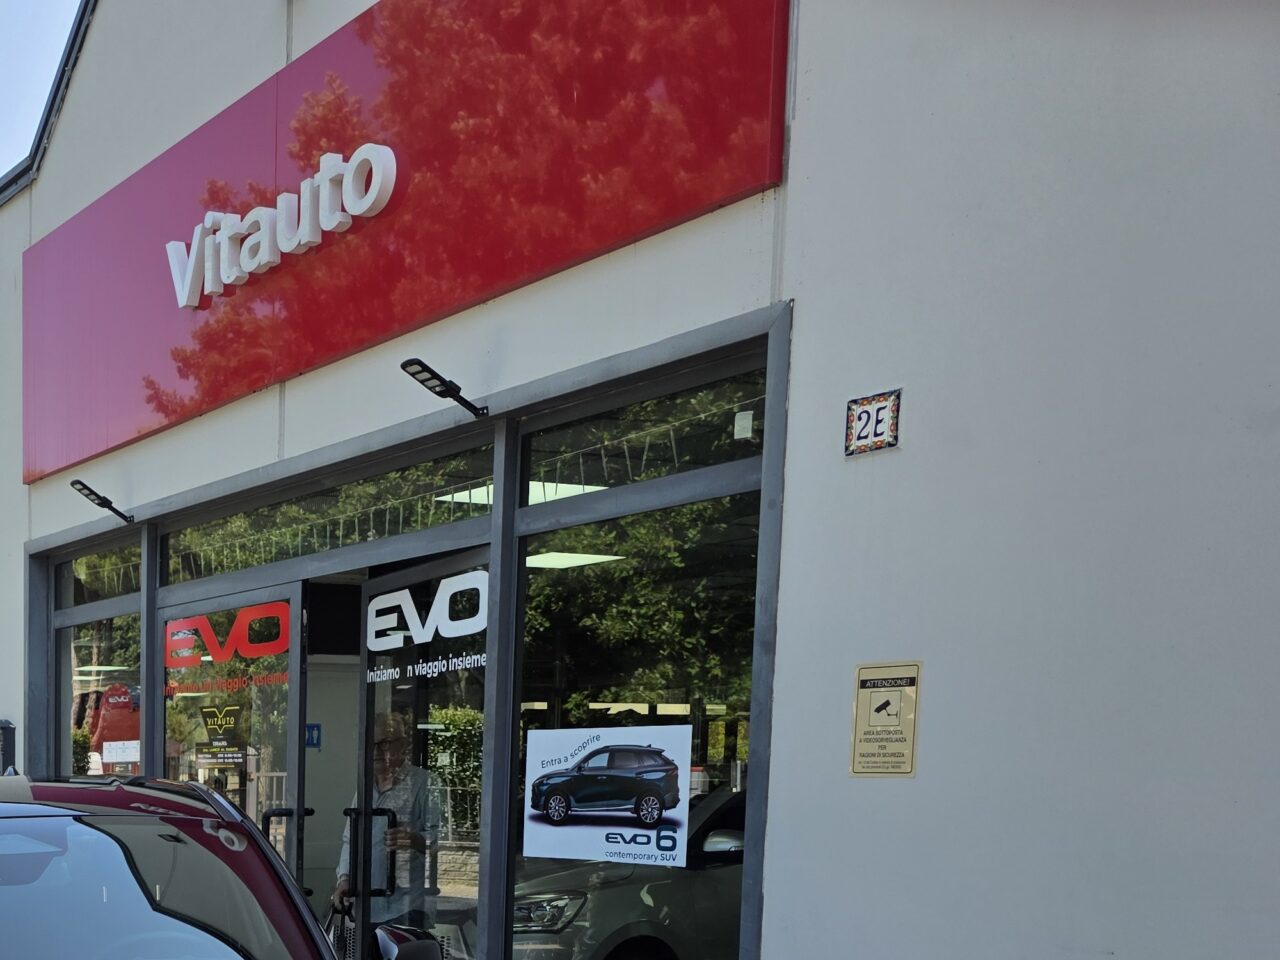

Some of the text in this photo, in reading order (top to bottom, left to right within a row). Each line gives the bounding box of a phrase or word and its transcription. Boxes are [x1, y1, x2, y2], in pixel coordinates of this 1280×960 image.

[166, 142, 397, 308] Vitauto
[856, 405, 888, 441] 2E
[366, 570, 489, 651] EVO
[164, 601, 290, 668] EVO
[367, 665, 400, 683] Iniziamo
[415, 656, 447, 678] viaggio
[449, 652, 487, 671] insieme
[866, 679, 910, 687] ATTENZIONE!
[207, 717, 235, 725] VITAUTO
[541, 733, 601, 769] Entra a scoprire
[605, 825, 677, 851] EVO 6
[605, 851, 678, 863] contemporary SUV
